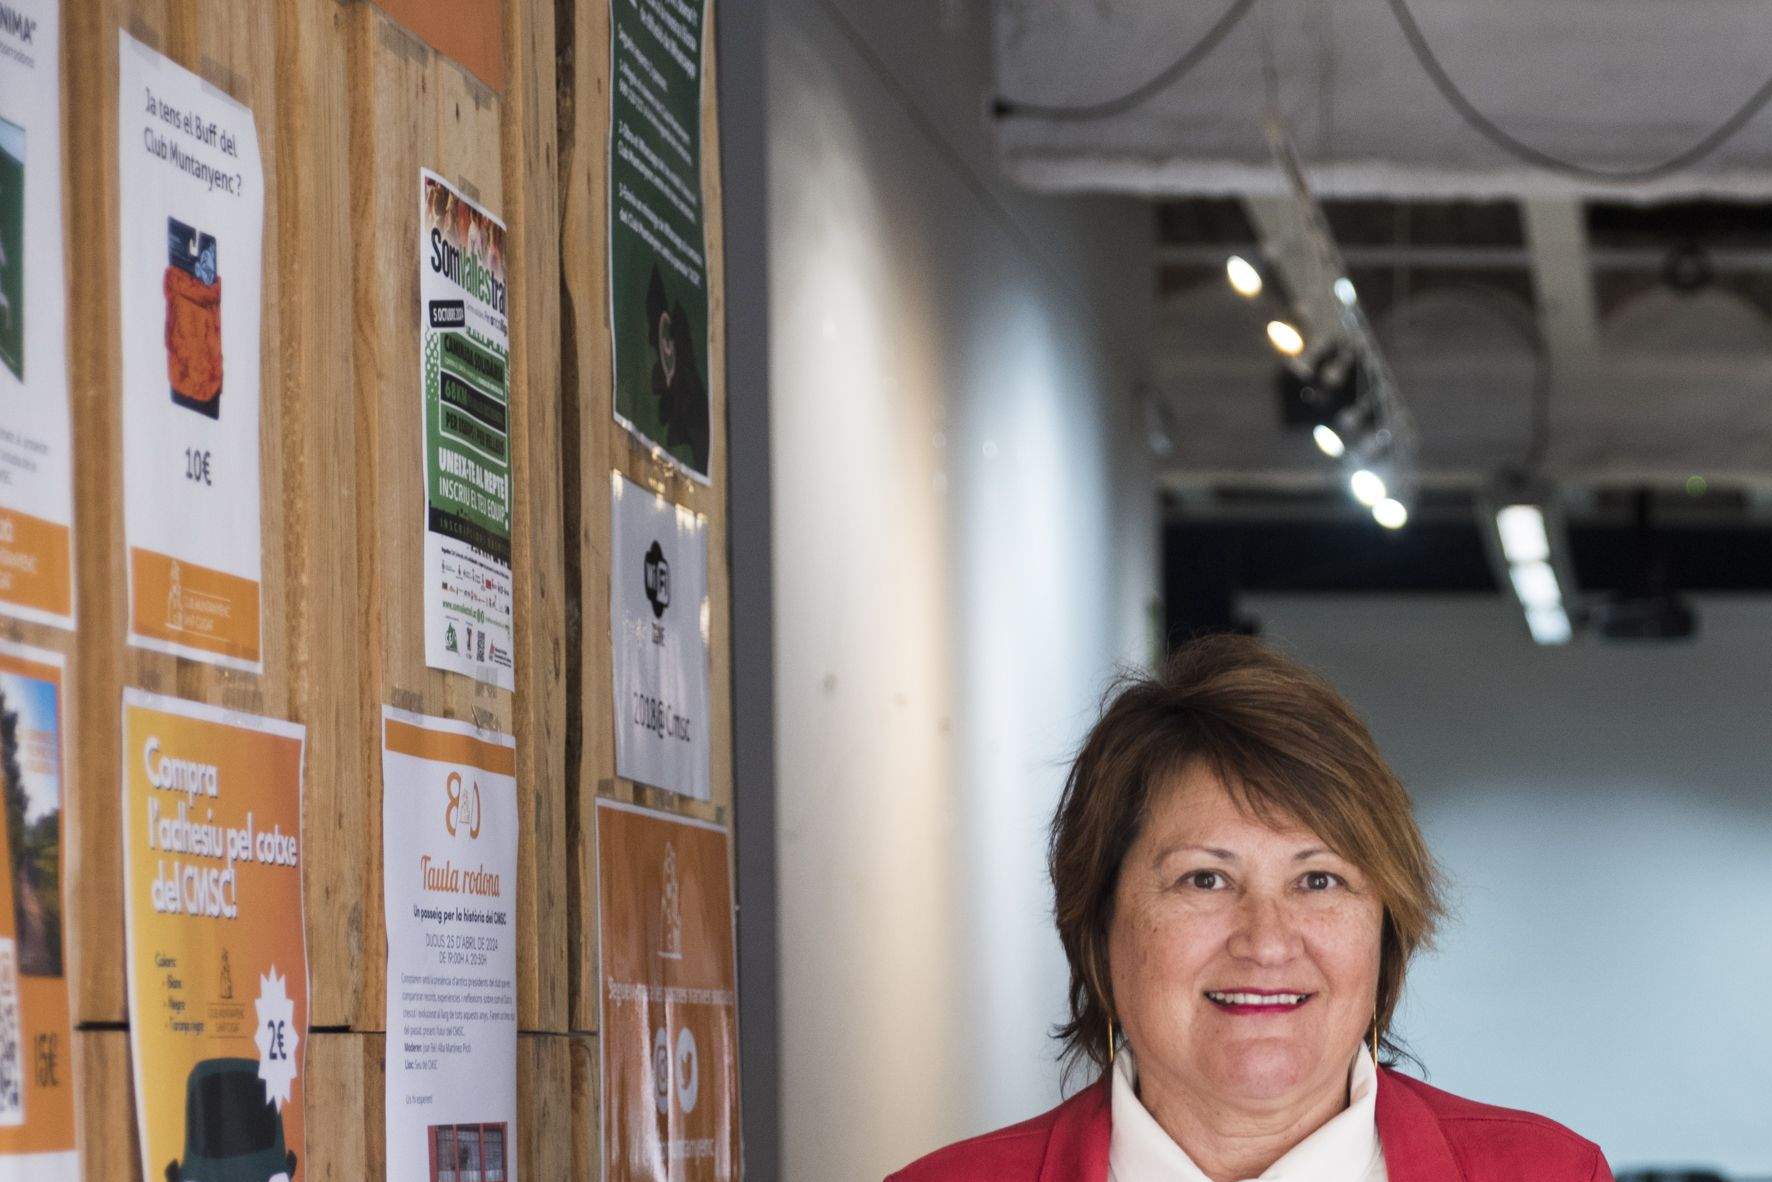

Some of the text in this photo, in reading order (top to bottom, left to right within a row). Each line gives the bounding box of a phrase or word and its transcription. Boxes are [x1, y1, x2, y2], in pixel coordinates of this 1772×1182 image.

[159, 98, 181, 129] tens
[183, 111, 193, 135] el
[195, 116, 217, 147] Buff
[220, 130, 238, 158] del
[144, 127, 167, 160] Club
[170, 140, 233, 194] Muntanyenc
[185, 446, 212, 487] 10€
[143, 735, 219, 808] Compra
[147, 795, 298, 869] l'adhesiu pel cotxe
[152, 859, 182, 914] del
[420, 854, 501, 898] Taula rodona
[421, 906, 442, 924] passeig
[443, 910, 455, 925] per
[456, 906, 463, 921] la
[478, 936, 485, 951] DE
[486, 937, 498, 952] 2024
[267, 1019, 287, 1061] 2€
